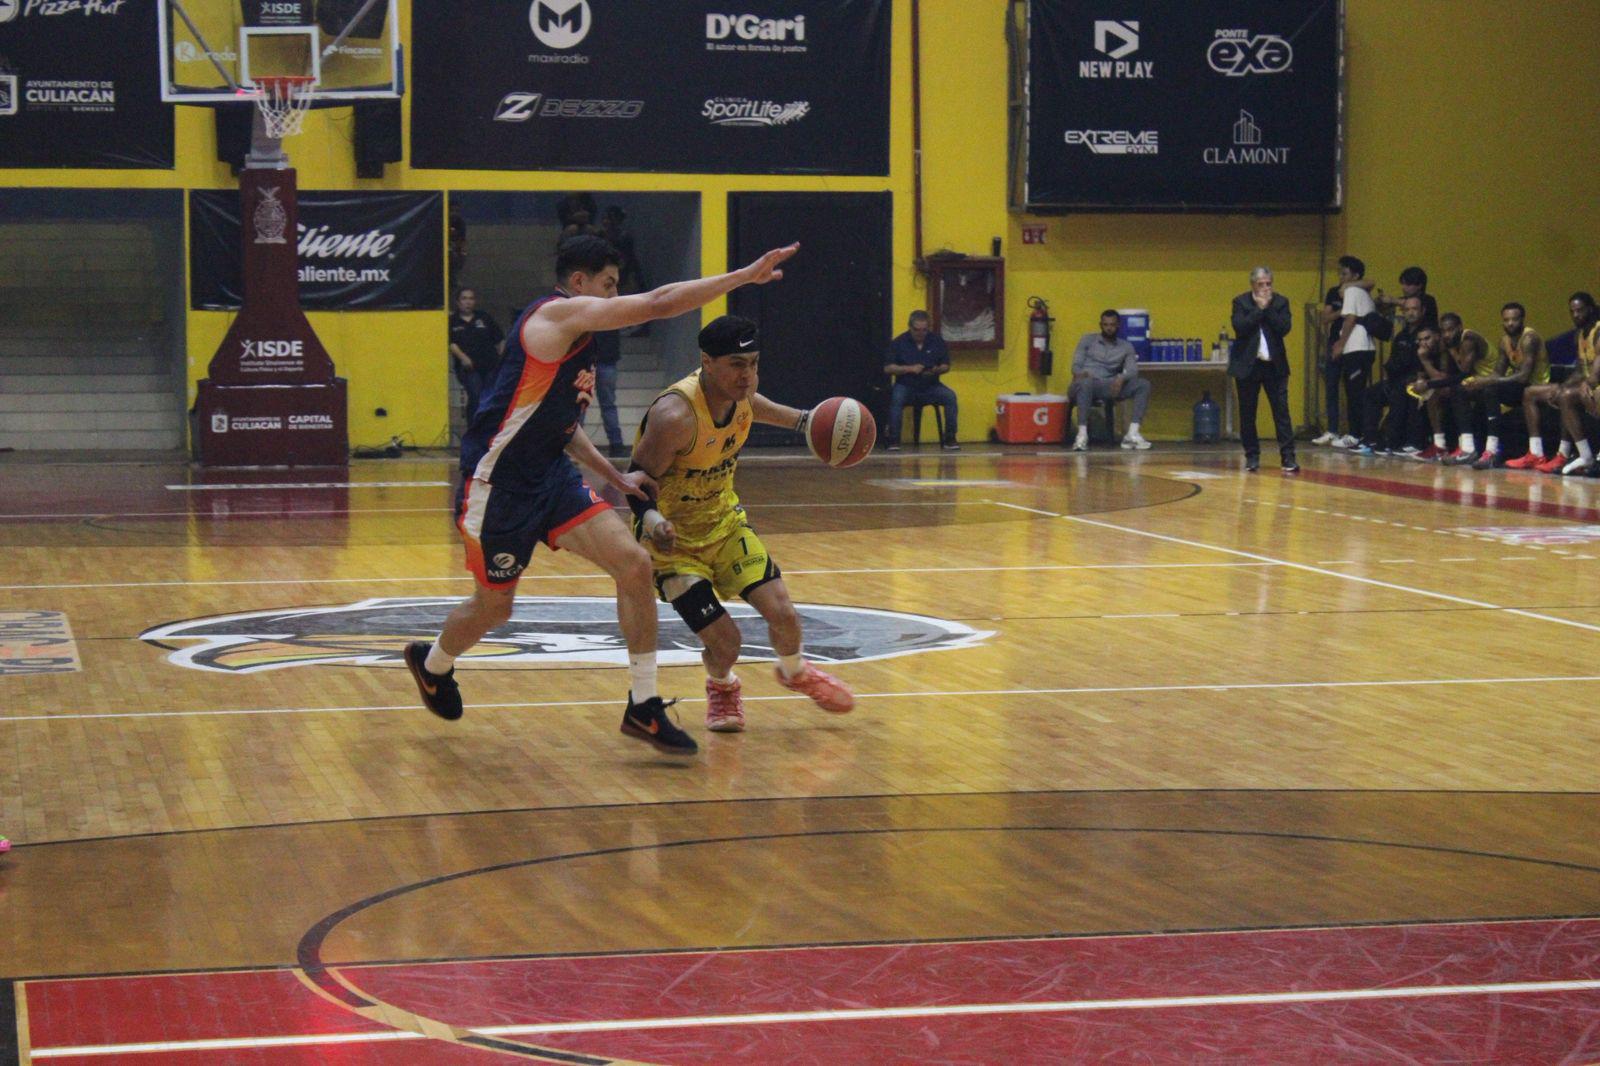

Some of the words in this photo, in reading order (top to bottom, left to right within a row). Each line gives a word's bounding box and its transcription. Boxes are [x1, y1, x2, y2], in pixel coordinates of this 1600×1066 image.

[24, 0, 80, 16] Pizza
[83, 0, 126, 16] Hut
[271, 3, 301, 14] ISDE
[706, 13, 805, 40] D'Gari
[1215, 29, 1248, 38] PONTE
[528, 53, 589, 64] maxiradio
[1079, 61, 1112, 78] NEW
[1115, 61, 1154, 78] PLAY
[540, 99, 645, 118] DEZZO
[701, 99, 782, 119] SportLife
[1065, 129, 1158, 145] EXTREME
[1203, 147, 1290, 164] CLAMONT
[297, 266, 390, 282] aliente.mx
[257, 340, 304, 357] ISDE
[288, 415, 333, 424] CAPITAL
[1033, 407, 1049, 426] G
[738, 537, 748, 555] 1
